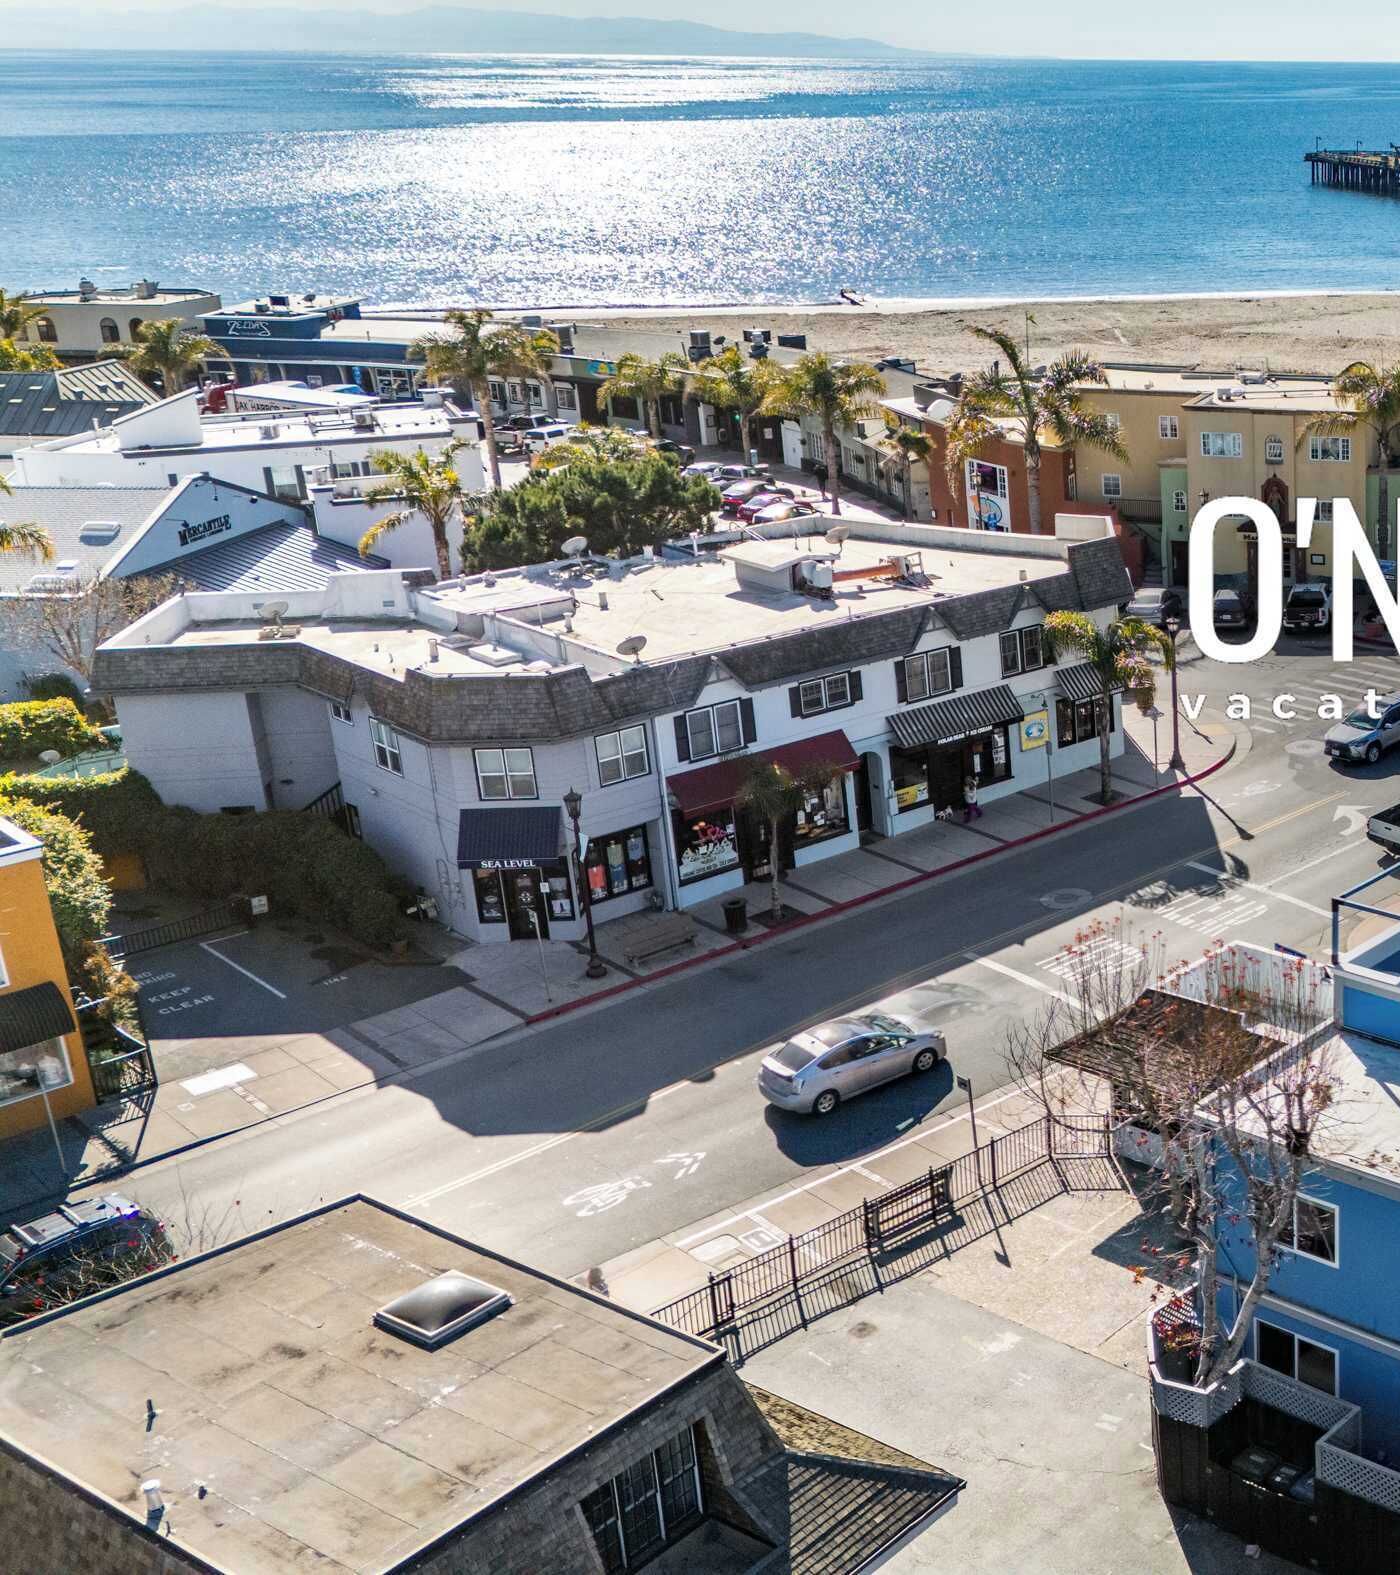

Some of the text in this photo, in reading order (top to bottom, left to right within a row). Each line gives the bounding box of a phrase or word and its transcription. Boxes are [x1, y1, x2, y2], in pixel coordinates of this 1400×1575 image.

[480, 859, 536, 869] SEA LEVEL
[148, 986, 192, 1004] KEEP
[158, 994, 216, 1015] CLEAR
